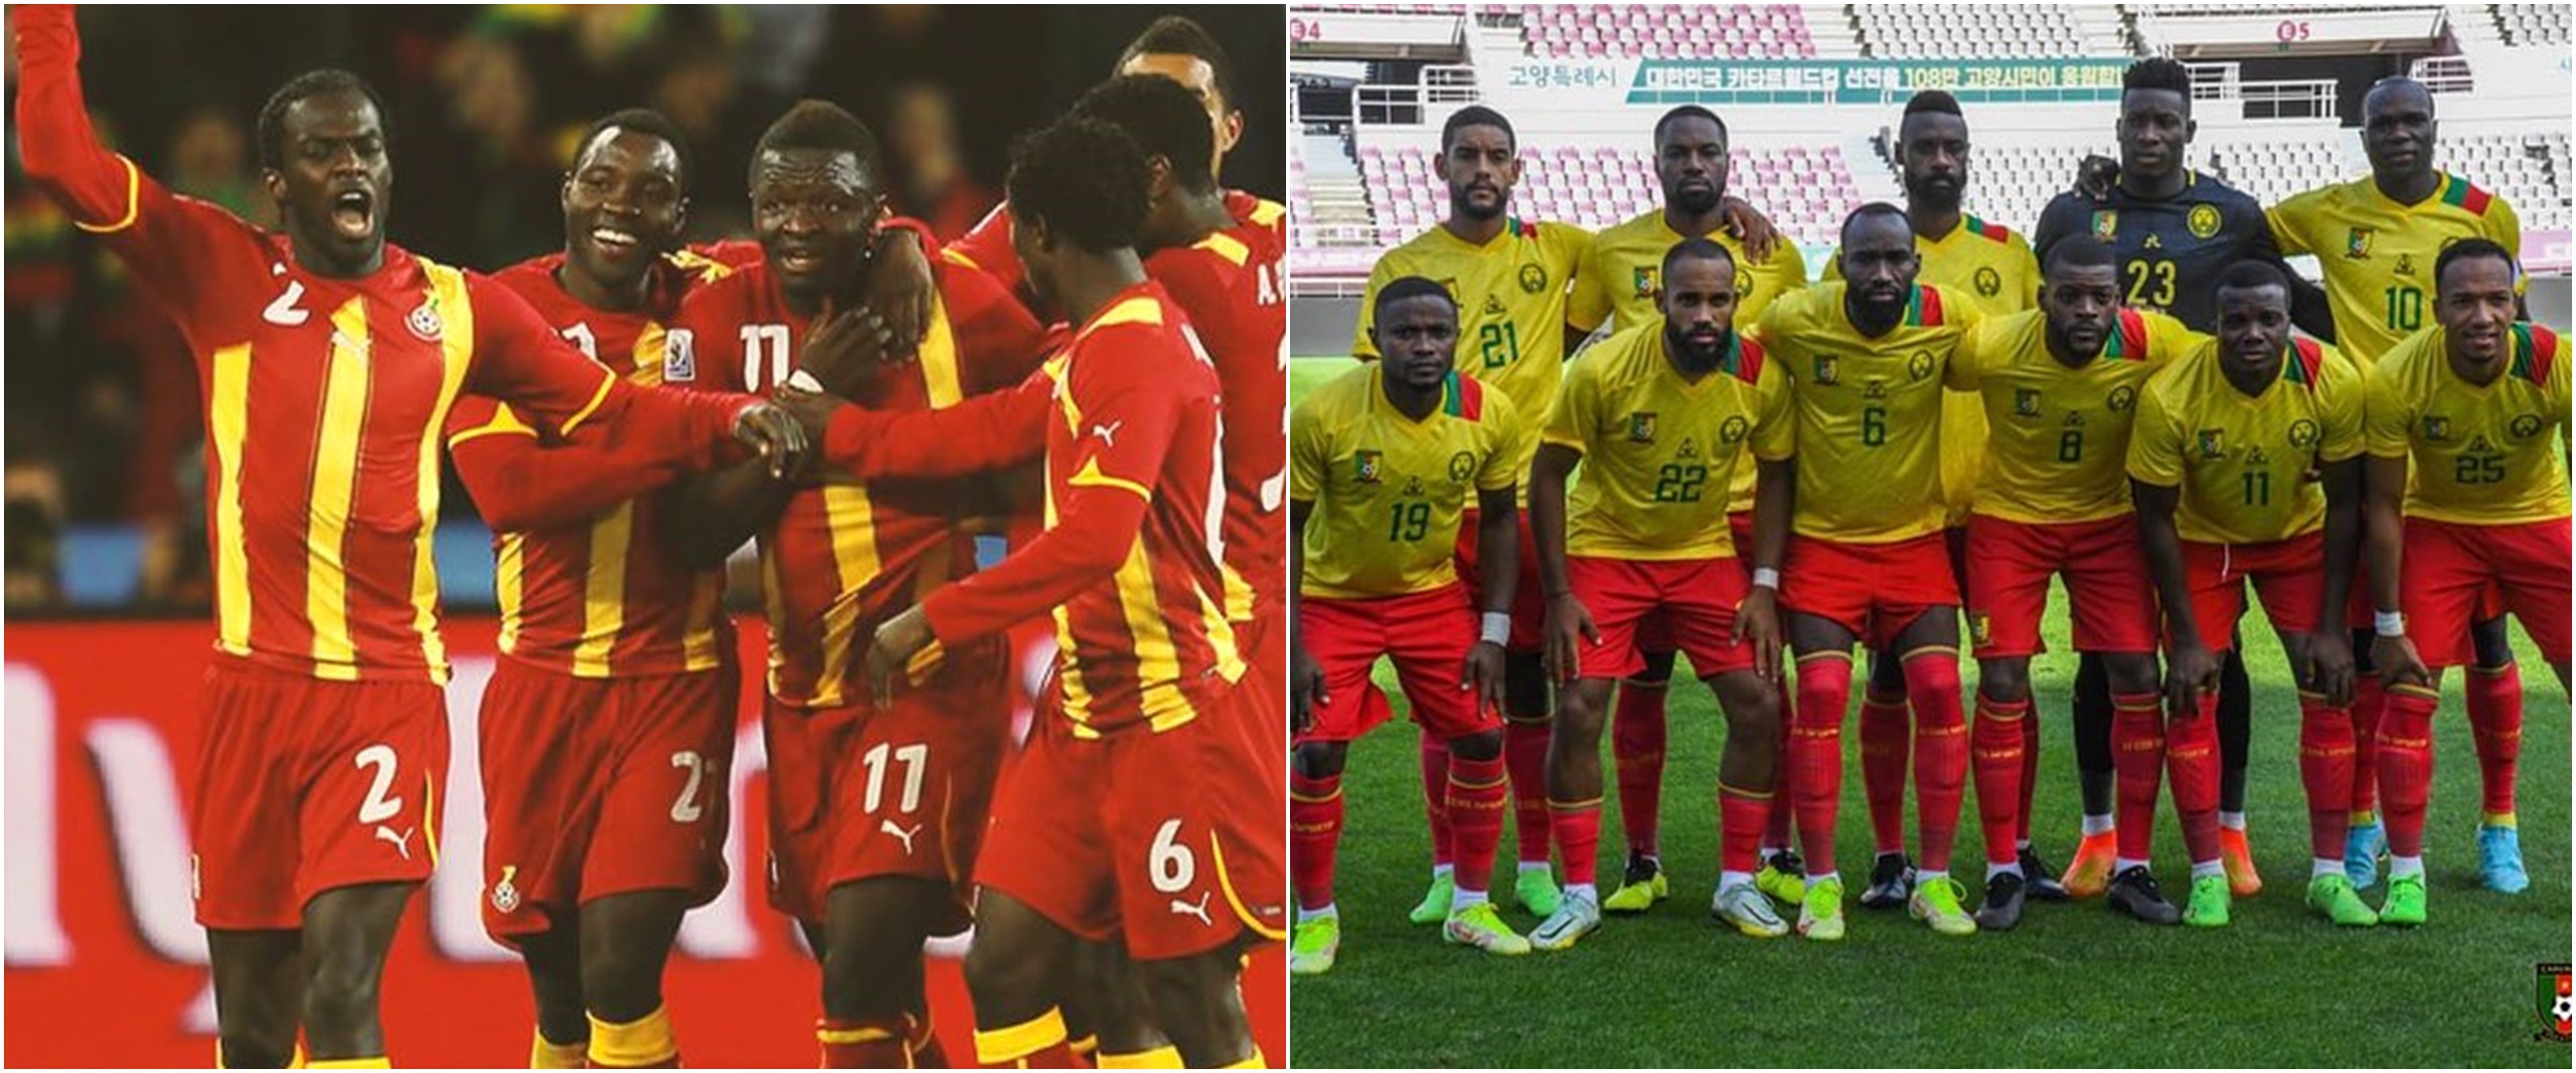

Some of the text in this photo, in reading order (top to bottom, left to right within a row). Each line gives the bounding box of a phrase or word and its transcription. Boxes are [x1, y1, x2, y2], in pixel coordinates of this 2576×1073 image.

[1509, 66, 1617, 87] 고양특례시
[1965, 66, 2055, 87] 고양시민이
[262, 262, 310, 325] 2
[2126, 259, 2176, 306] 23
[2385, 286, 2422, 331] 10
[740, 324, 789, 392] 11
[1481, 323, 1518, 368] 21
[1862, 407, 1885, 446] 6
[2059, 430, 2082, 463] 8
[1657, 465, 1705, 502] 22
[2242, 472, 2268, 506] 11
[2457, 455, 2505, 484] 25
[1391, 503, 1429, 541] 19
[356, 745, 402, 823] 2
[863, 743, 927, 813] 11
[1149, 819, 1195, 892] 6
